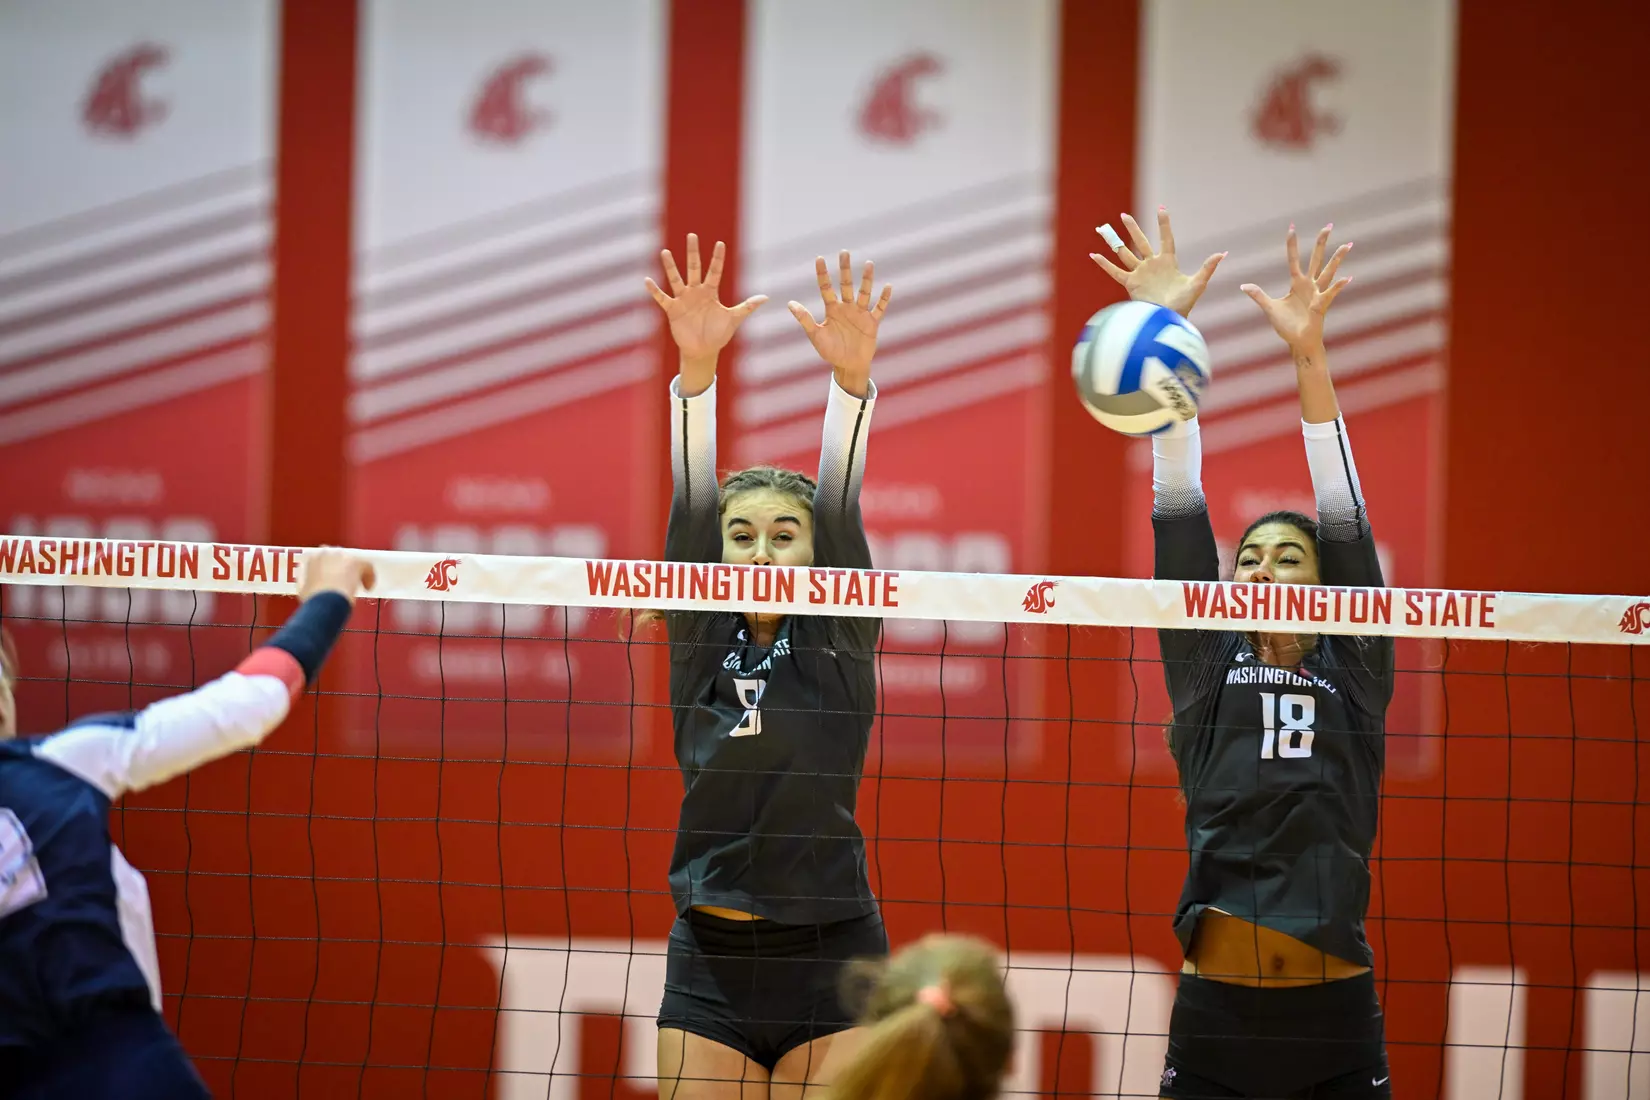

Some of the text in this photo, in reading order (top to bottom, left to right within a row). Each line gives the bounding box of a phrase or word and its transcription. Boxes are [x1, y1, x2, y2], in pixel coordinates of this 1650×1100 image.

[0, 539, 303, 583] WASHINGTON STATE
[586, 561, 899, 607] WASHINGTON STATE
[1183, 583, 1497, 628] WASHINGTON STATE
[1259, 692, 1316, 759] 18
